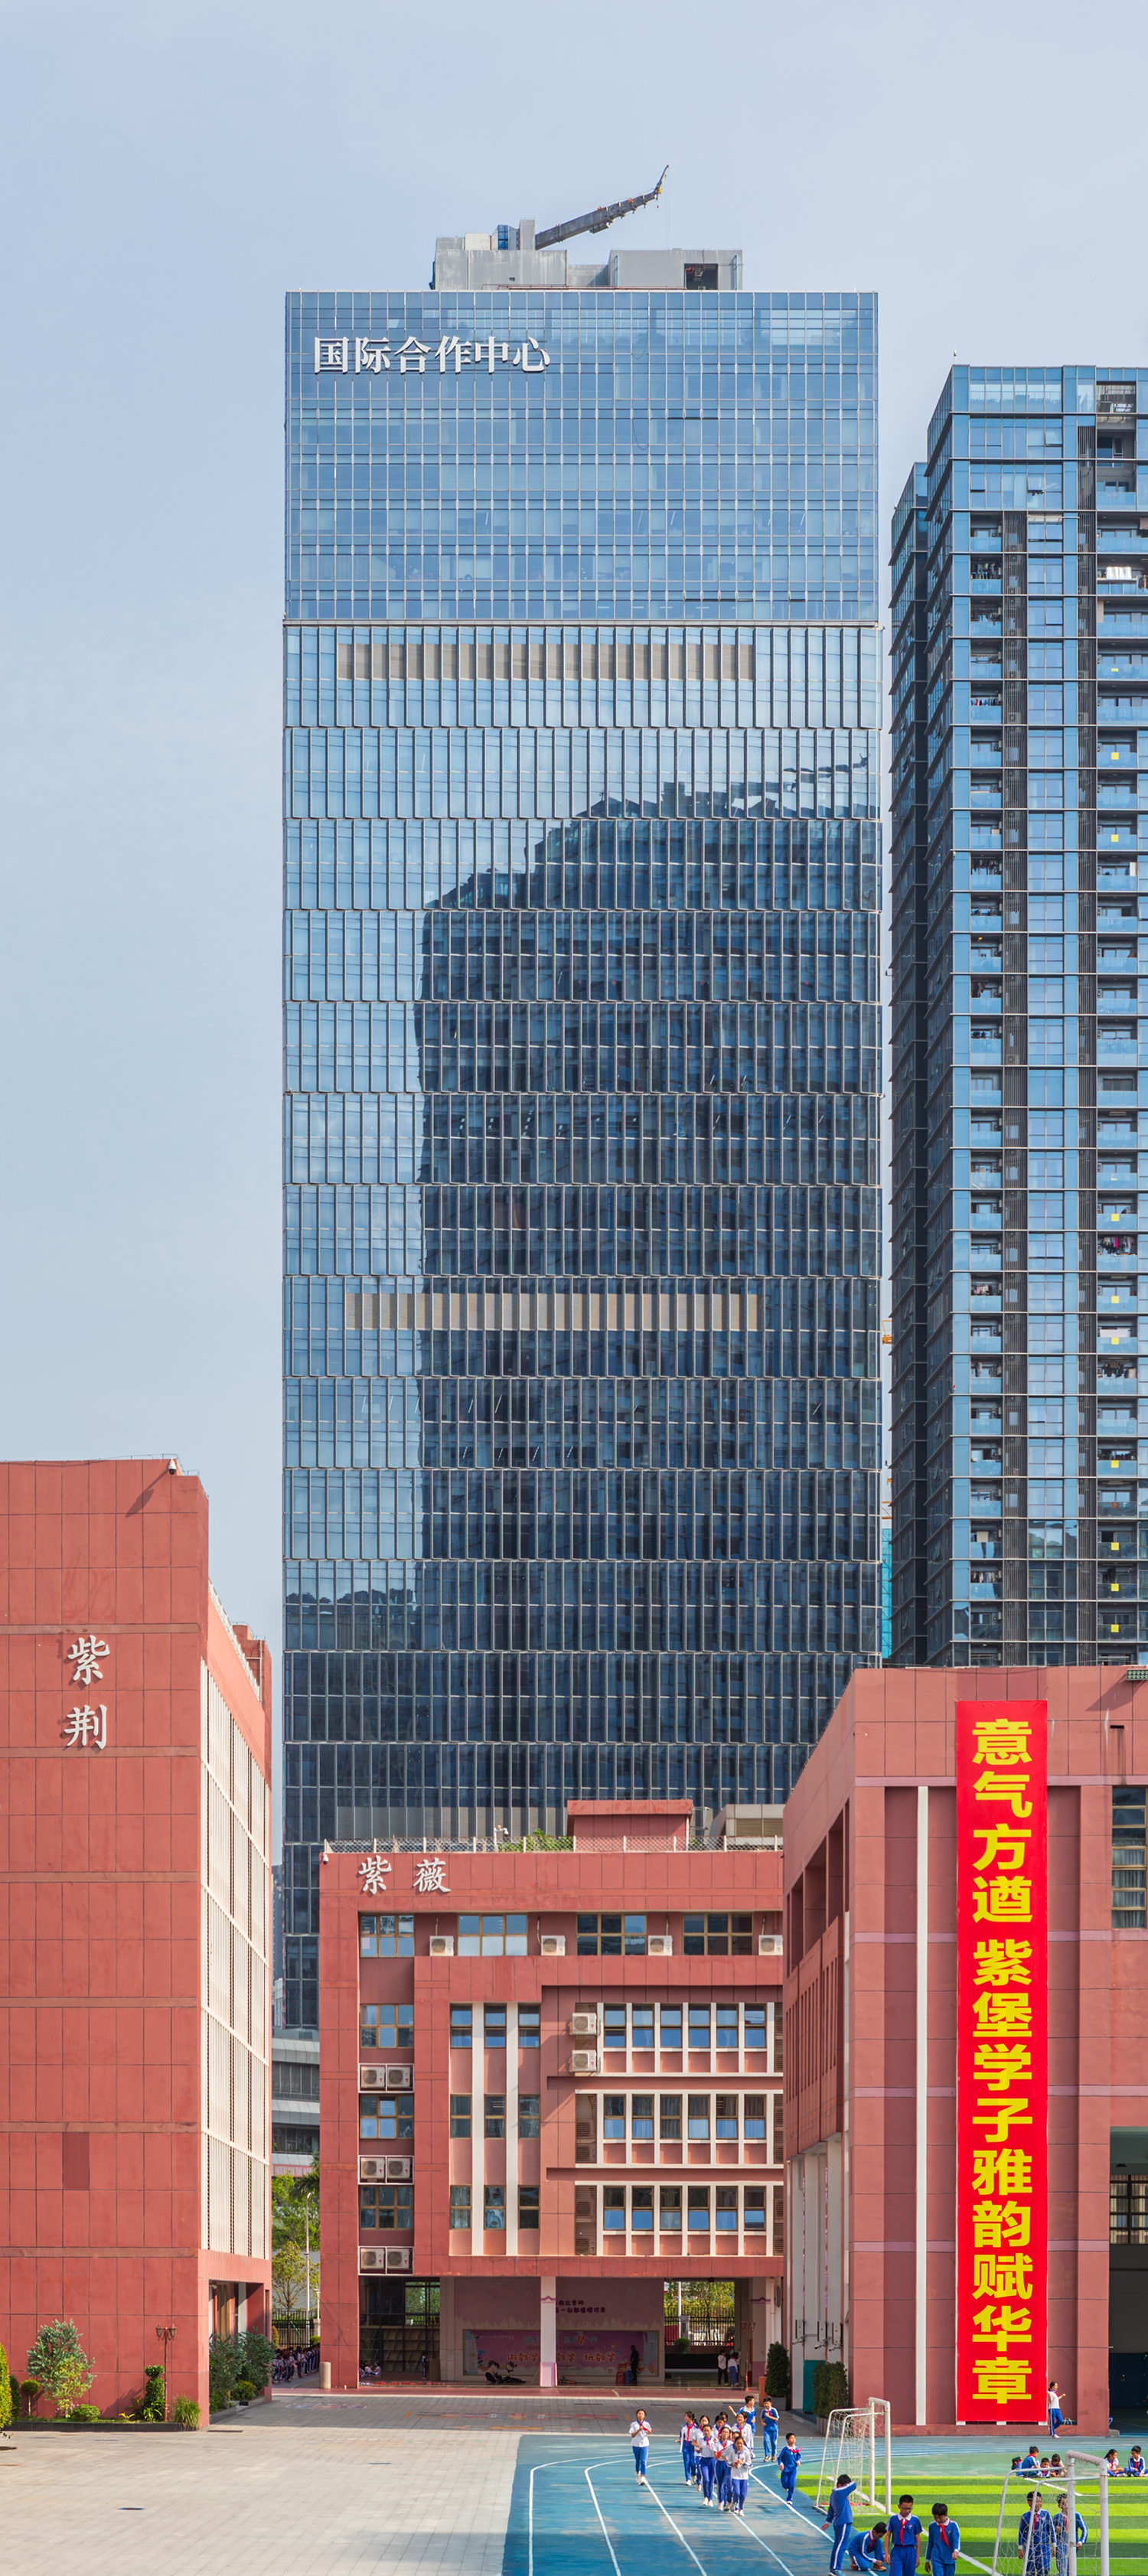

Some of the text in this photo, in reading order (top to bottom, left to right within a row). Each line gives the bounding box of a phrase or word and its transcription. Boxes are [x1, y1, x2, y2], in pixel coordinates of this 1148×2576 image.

[315, 335, 550, 374] 国际合作中心
[64, 1635, 110, 1749] 紫荆
[358, 1855, 452, 1895] 紫薇
[972, 1719, 1033, 2404] 意气方遒 紫堡学子雅韵赋华章
[583, 2351, 615, 2362] 玩数学
